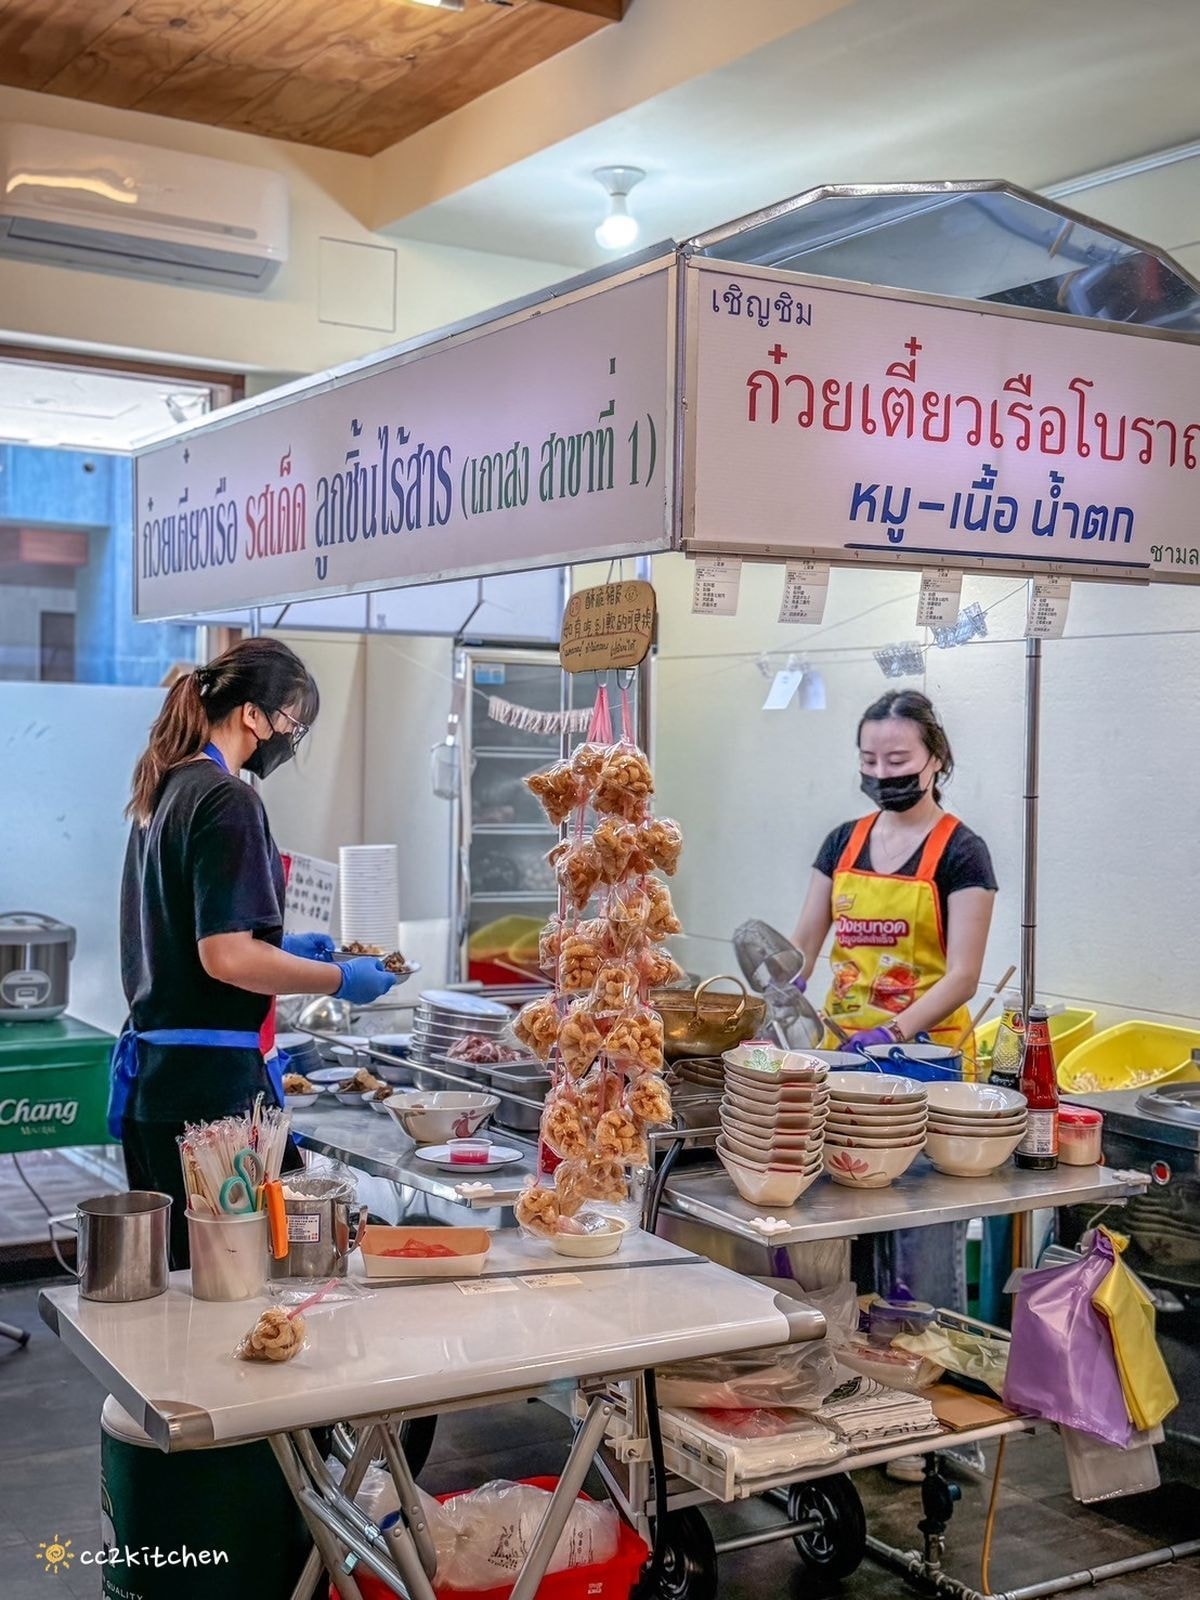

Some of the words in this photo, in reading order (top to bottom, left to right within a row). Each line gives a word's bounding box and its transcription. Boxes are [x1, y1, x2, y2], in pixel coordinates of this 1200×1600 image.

[712, 283, 813, 327] เชิญชิม
[143, 449, 238, 579] ก๋วยเตี๋ยวเรือ
[245, 444, 306, 561] รสเด็ด
[315, 418, 453, 581] ลูกชิ้นไร้สาร
[539, 357, 616, 502] สาขาที่
[628, 413, 657, 488] 1)
[1032, 470, 1134, 543] น้ำตก
[0, 1098, 79, 1125] Chang
